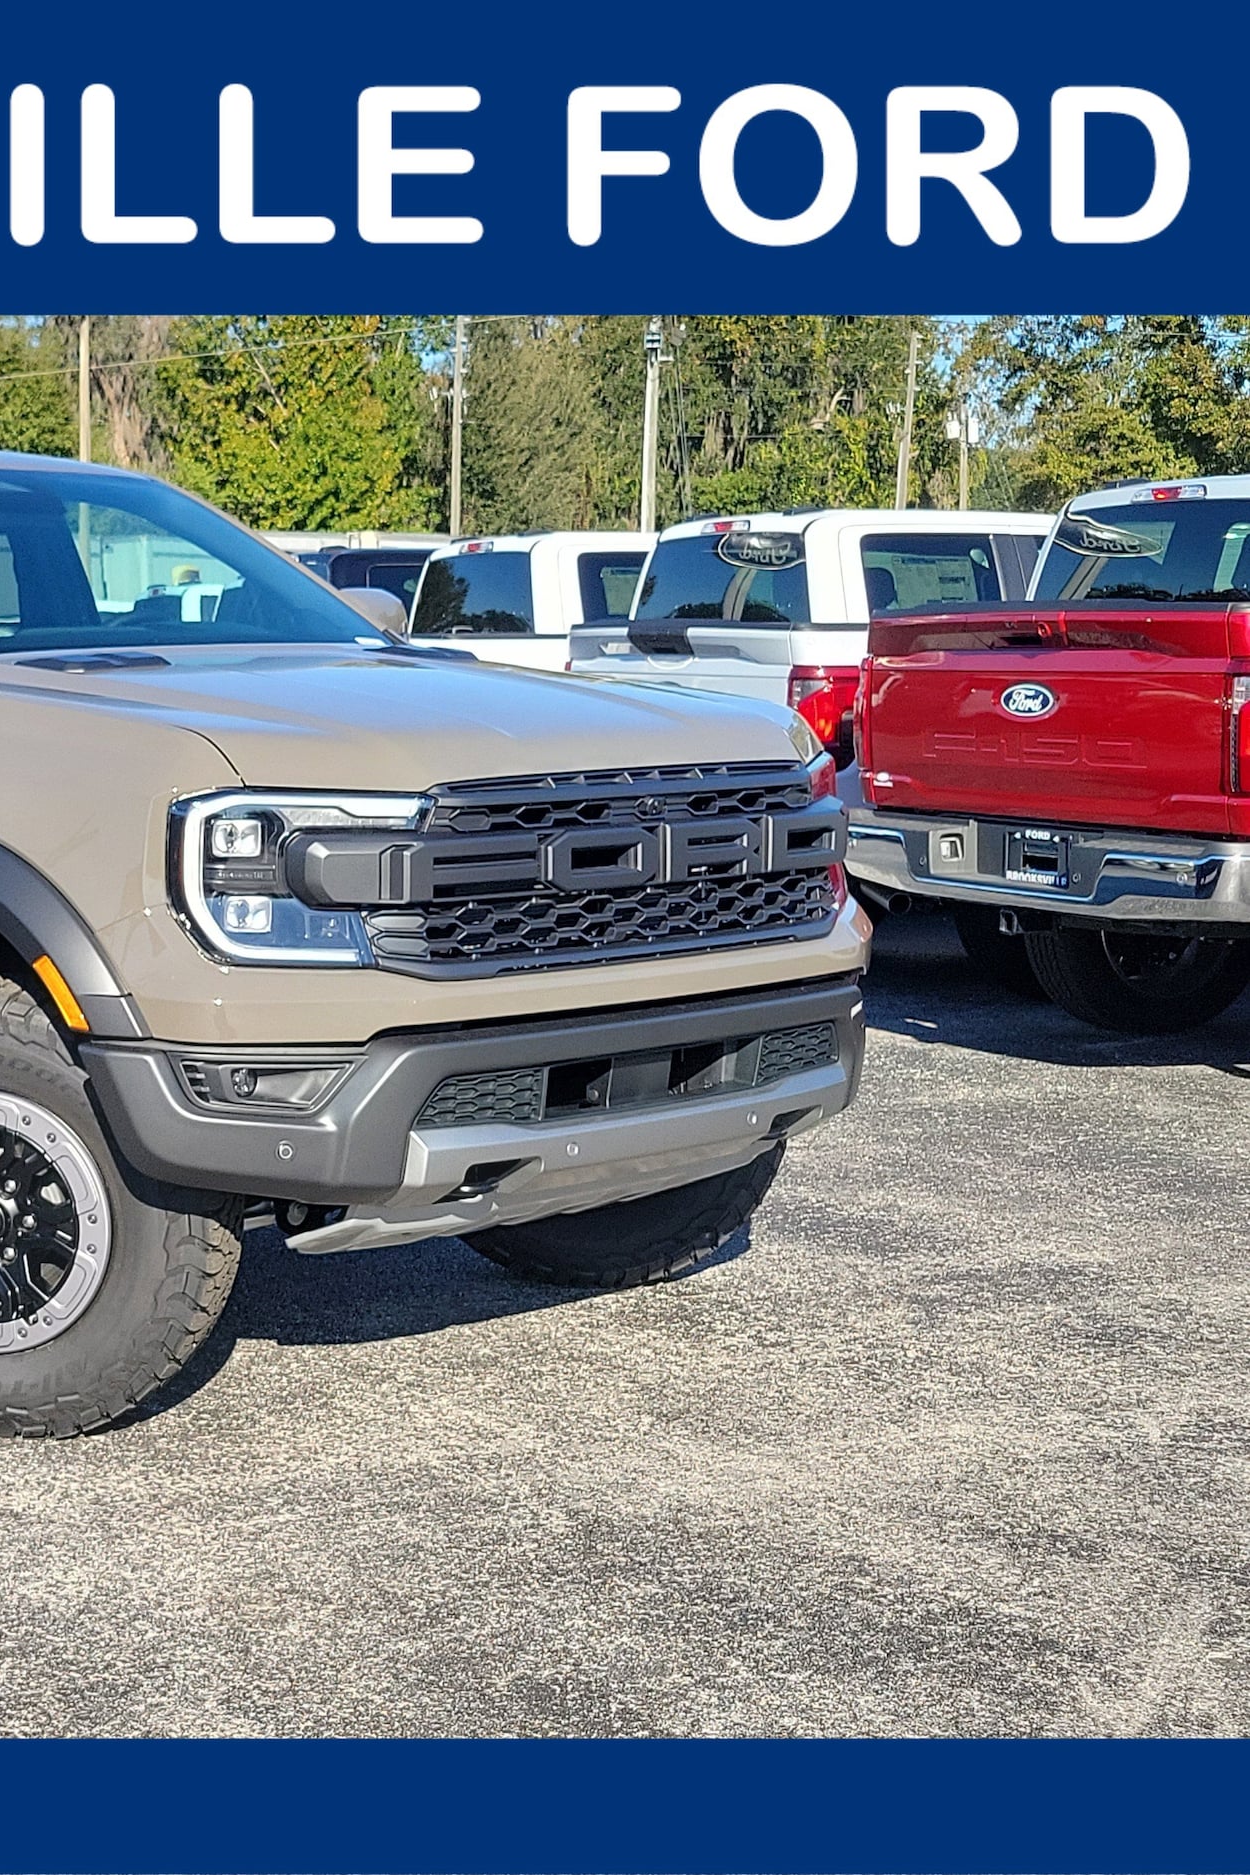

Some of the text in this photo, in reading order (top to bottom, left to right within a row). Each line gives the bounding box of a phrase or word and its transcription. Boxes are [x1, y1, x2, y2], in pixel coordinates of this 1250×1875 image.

[1007, 688, 1046, 713] Ford
[921, 731, 1147, 769] F-150
[1024, 828, 1052, 841] FORD
[380, 800, 847, 905] FORD
